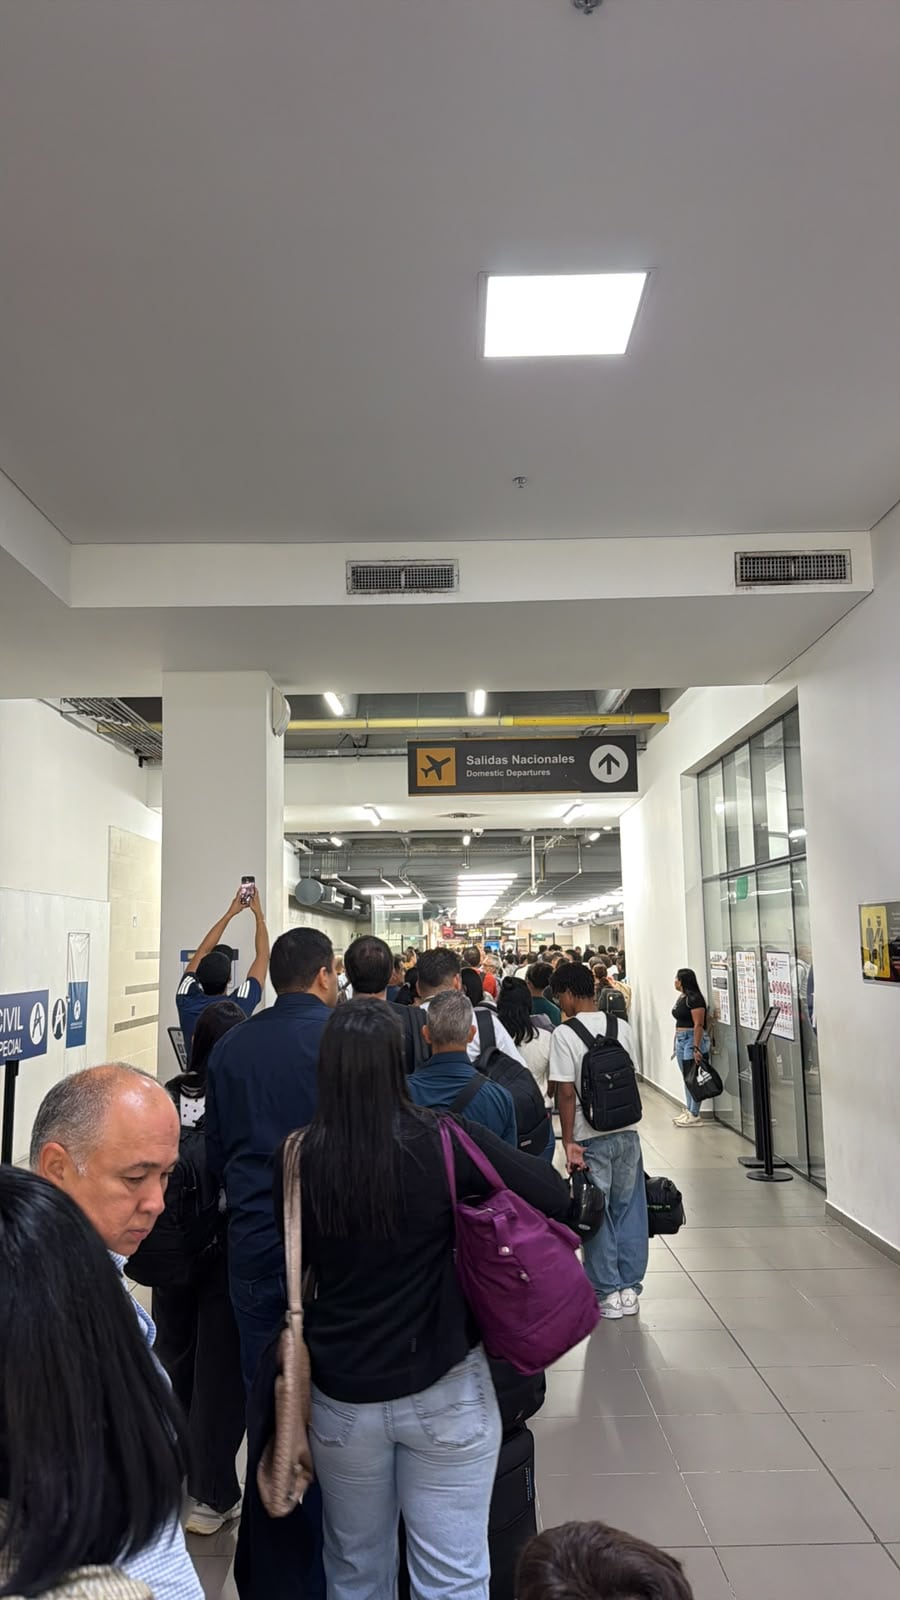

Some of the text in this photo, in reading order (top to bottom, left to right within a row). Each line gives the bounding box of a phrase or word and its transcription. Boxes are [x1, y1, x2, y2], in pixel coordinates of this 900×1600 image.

[466, 753, 575, 765] Salidas Nacionales
[466, 768, 551, 778] Domestic Departures
